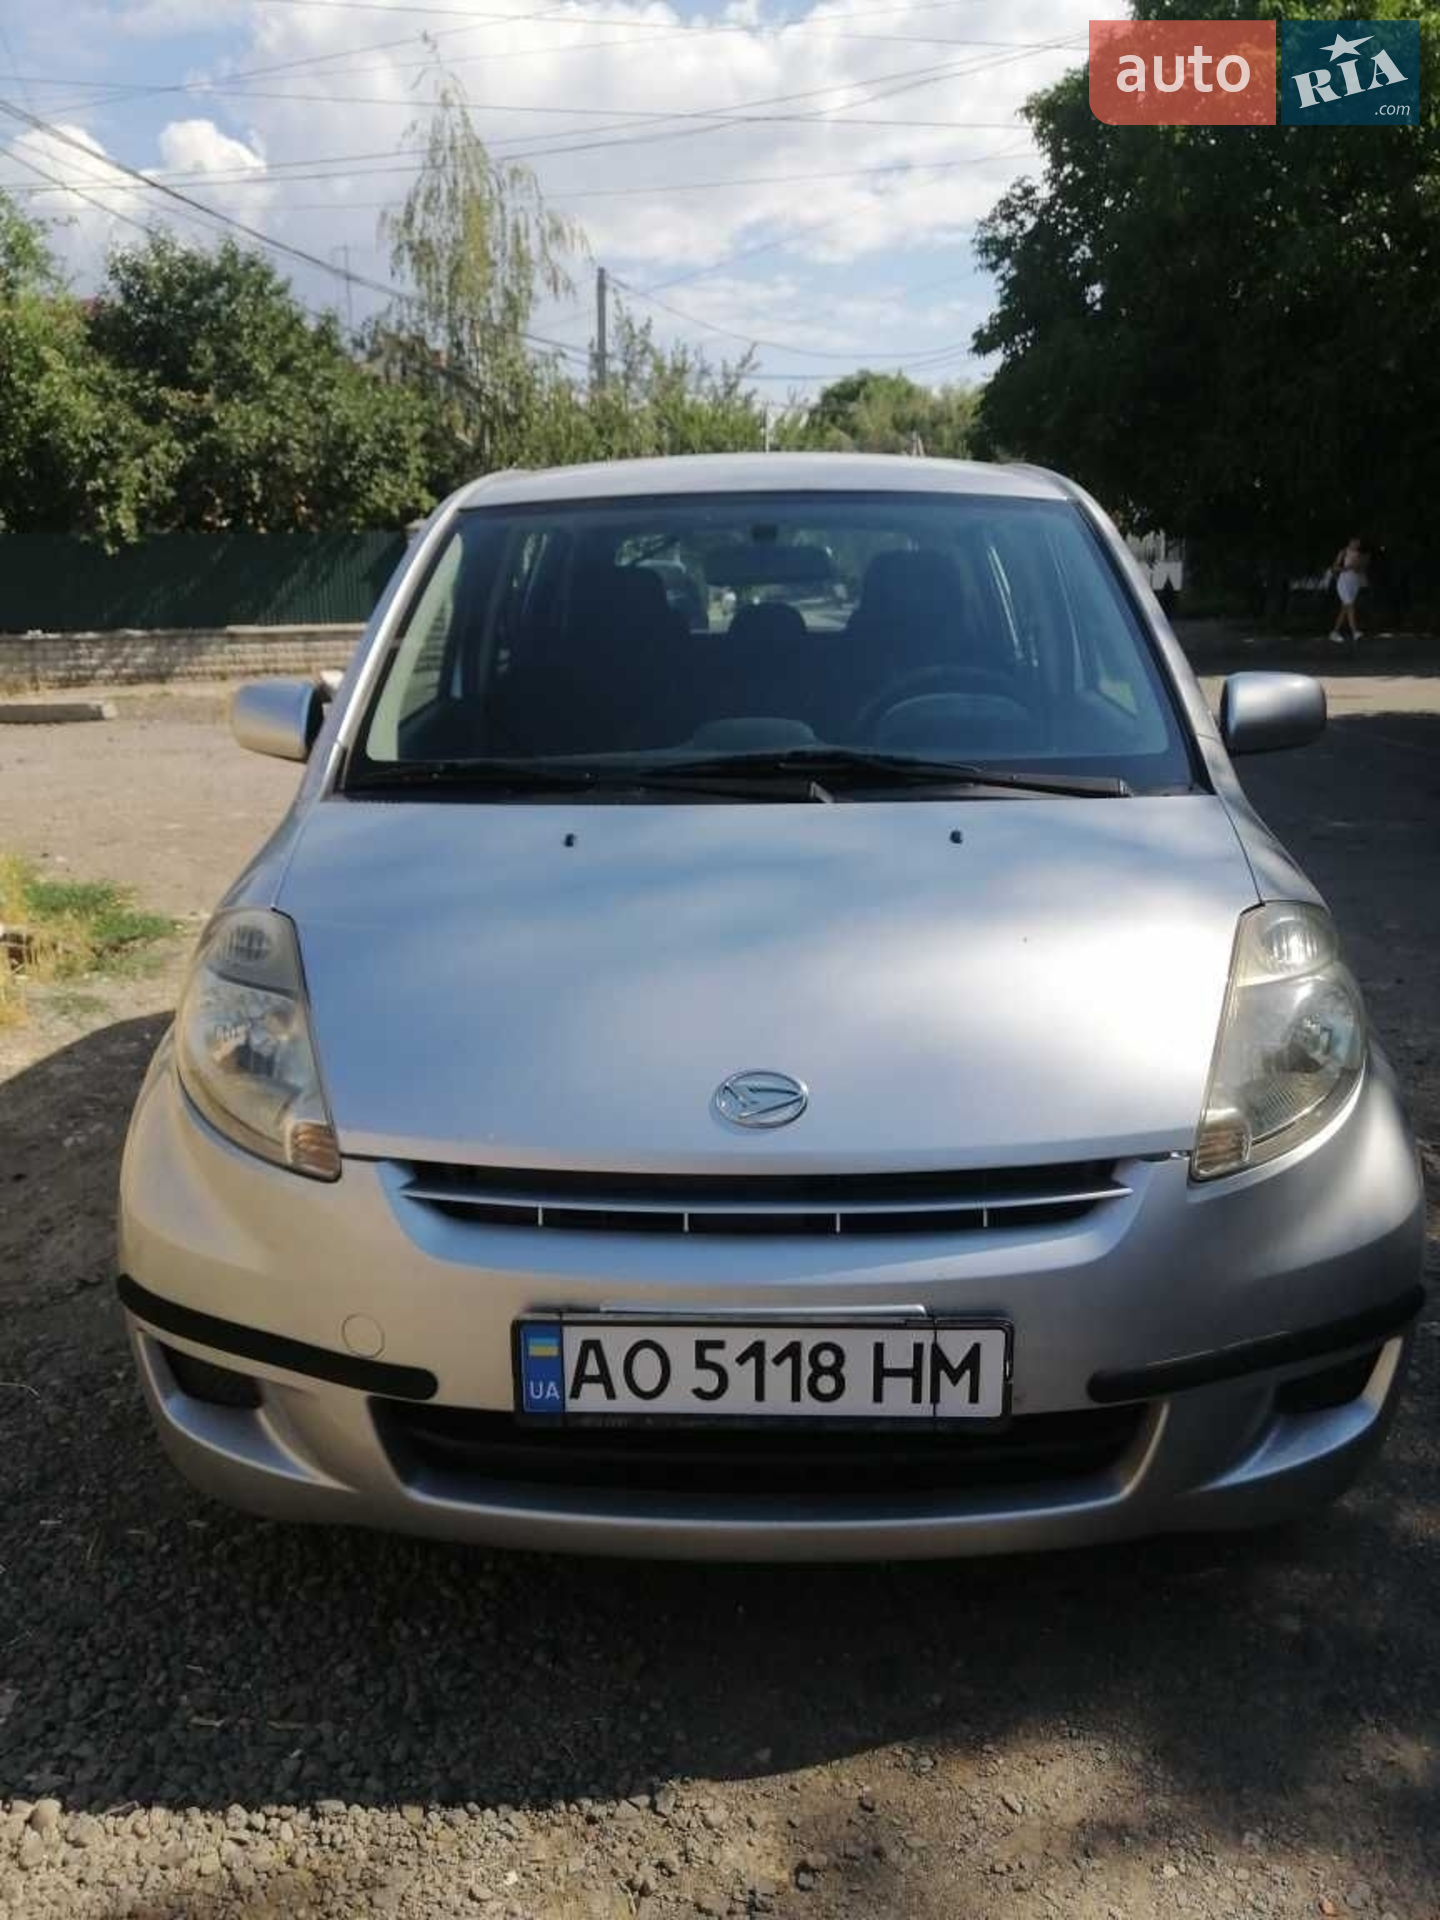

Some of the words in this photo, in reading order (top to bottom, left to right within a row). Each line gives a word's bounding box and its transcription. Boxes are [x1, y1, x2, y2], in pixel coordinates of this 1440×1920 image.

[529, 1382, 560, 1400] UA
[569, 1339, 672, 1400] AO
[691, 1339, 846, 1403] 5118
[872, 1341, 981, 1404] HM
